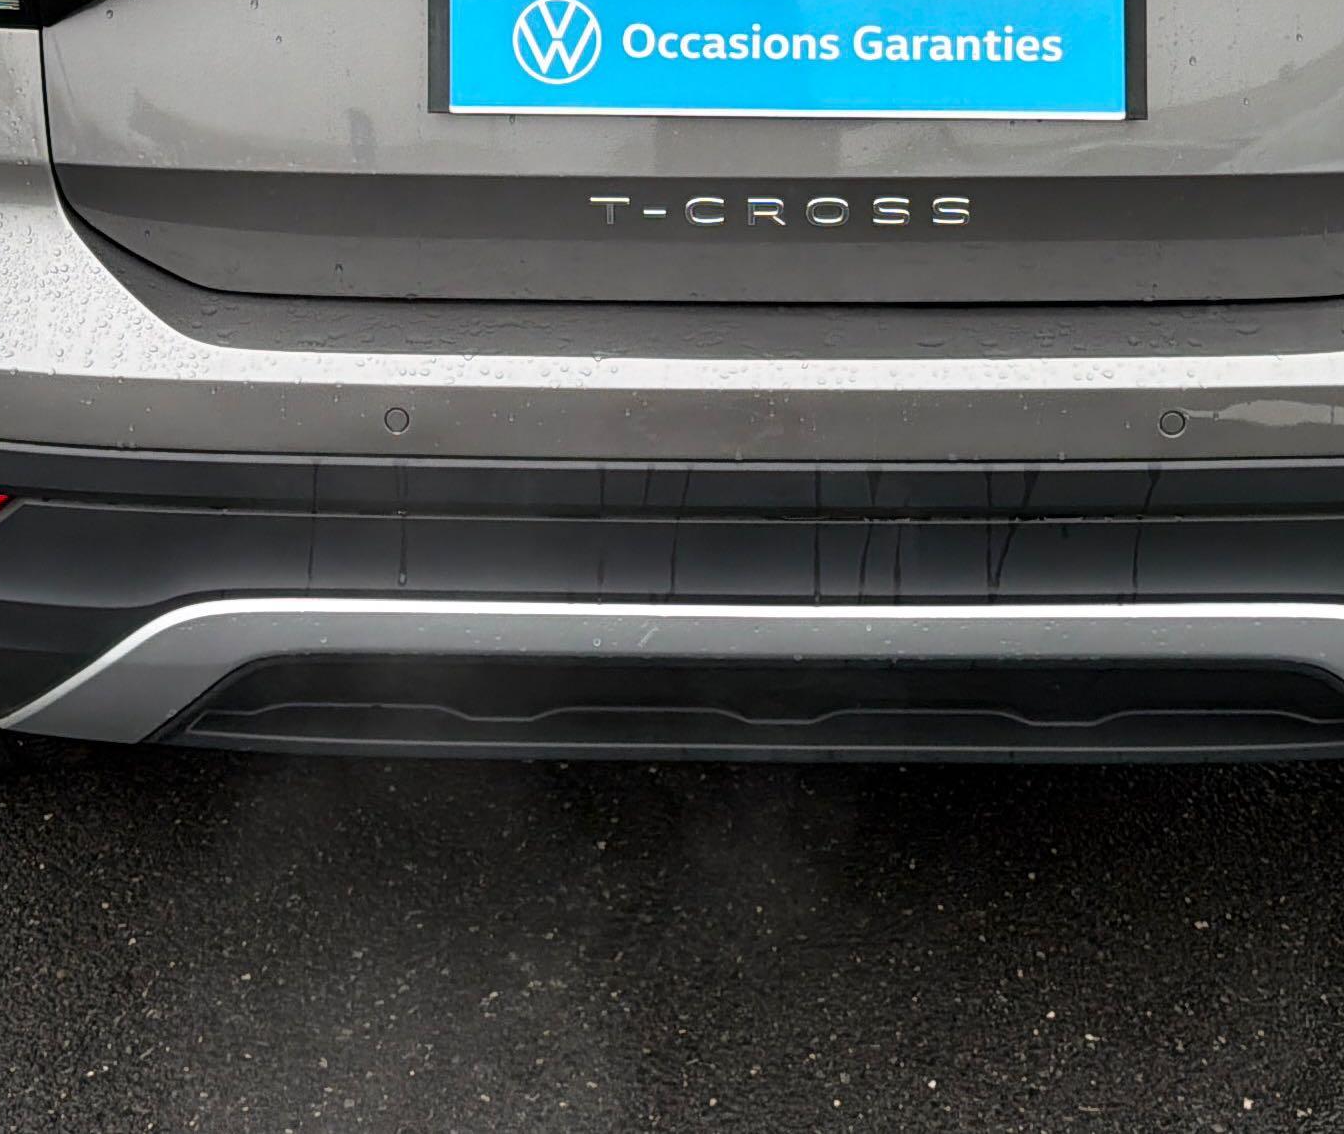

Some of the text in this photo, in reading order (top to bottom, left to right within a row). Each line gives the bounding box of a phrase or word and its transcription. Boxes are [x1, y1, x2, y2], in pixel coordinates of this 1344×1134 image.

[621, 23, 839, 62] Occasions
[853, 25, 1063, 64] Garanties
[589, 196, 971, 227] T-CROSS
